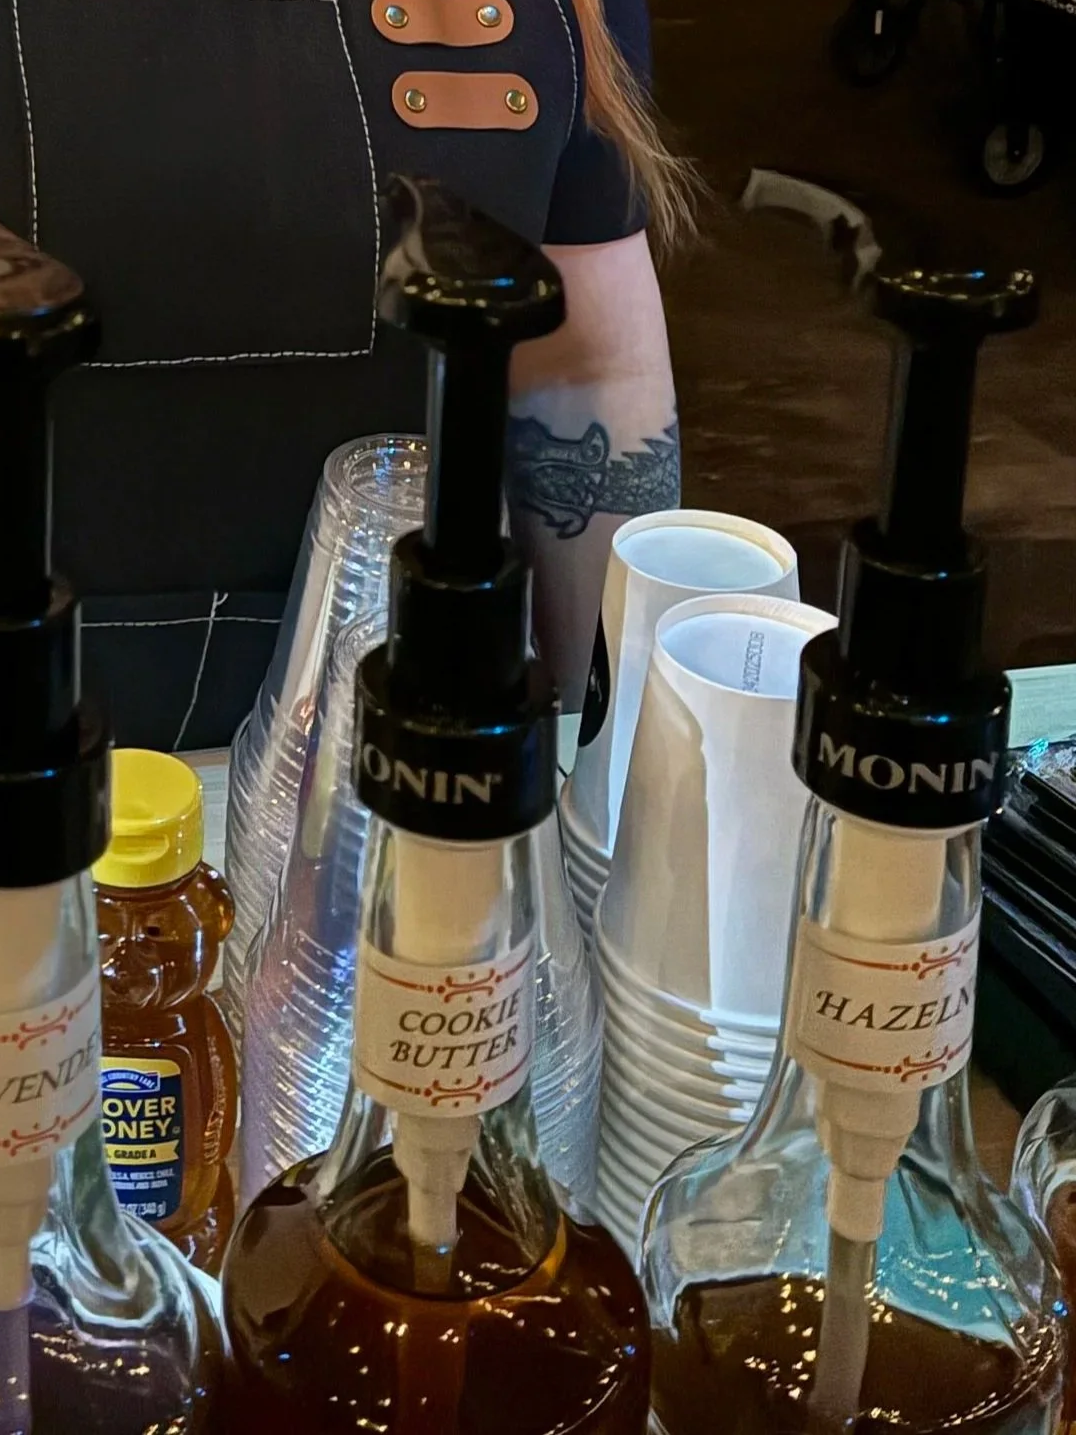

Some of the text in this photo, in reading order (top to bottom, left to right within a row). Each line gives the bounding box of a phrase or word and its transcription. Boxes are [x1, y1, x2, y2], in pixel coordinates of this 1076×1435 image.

[363, 742, 497, 804] ONIN
[818, 732, 1000, 794] MONIN
[399, 990, 523, 1034] COOKIE
[816, 984, 975, 1032] HAZELN
[389, 1024, 518, 1069] BUTTER
[102, 1096, 176, 1117] OVER
[102, 1118, 173, 1140] ONEY
[114, 1149, 157, 1160] GRADE A
